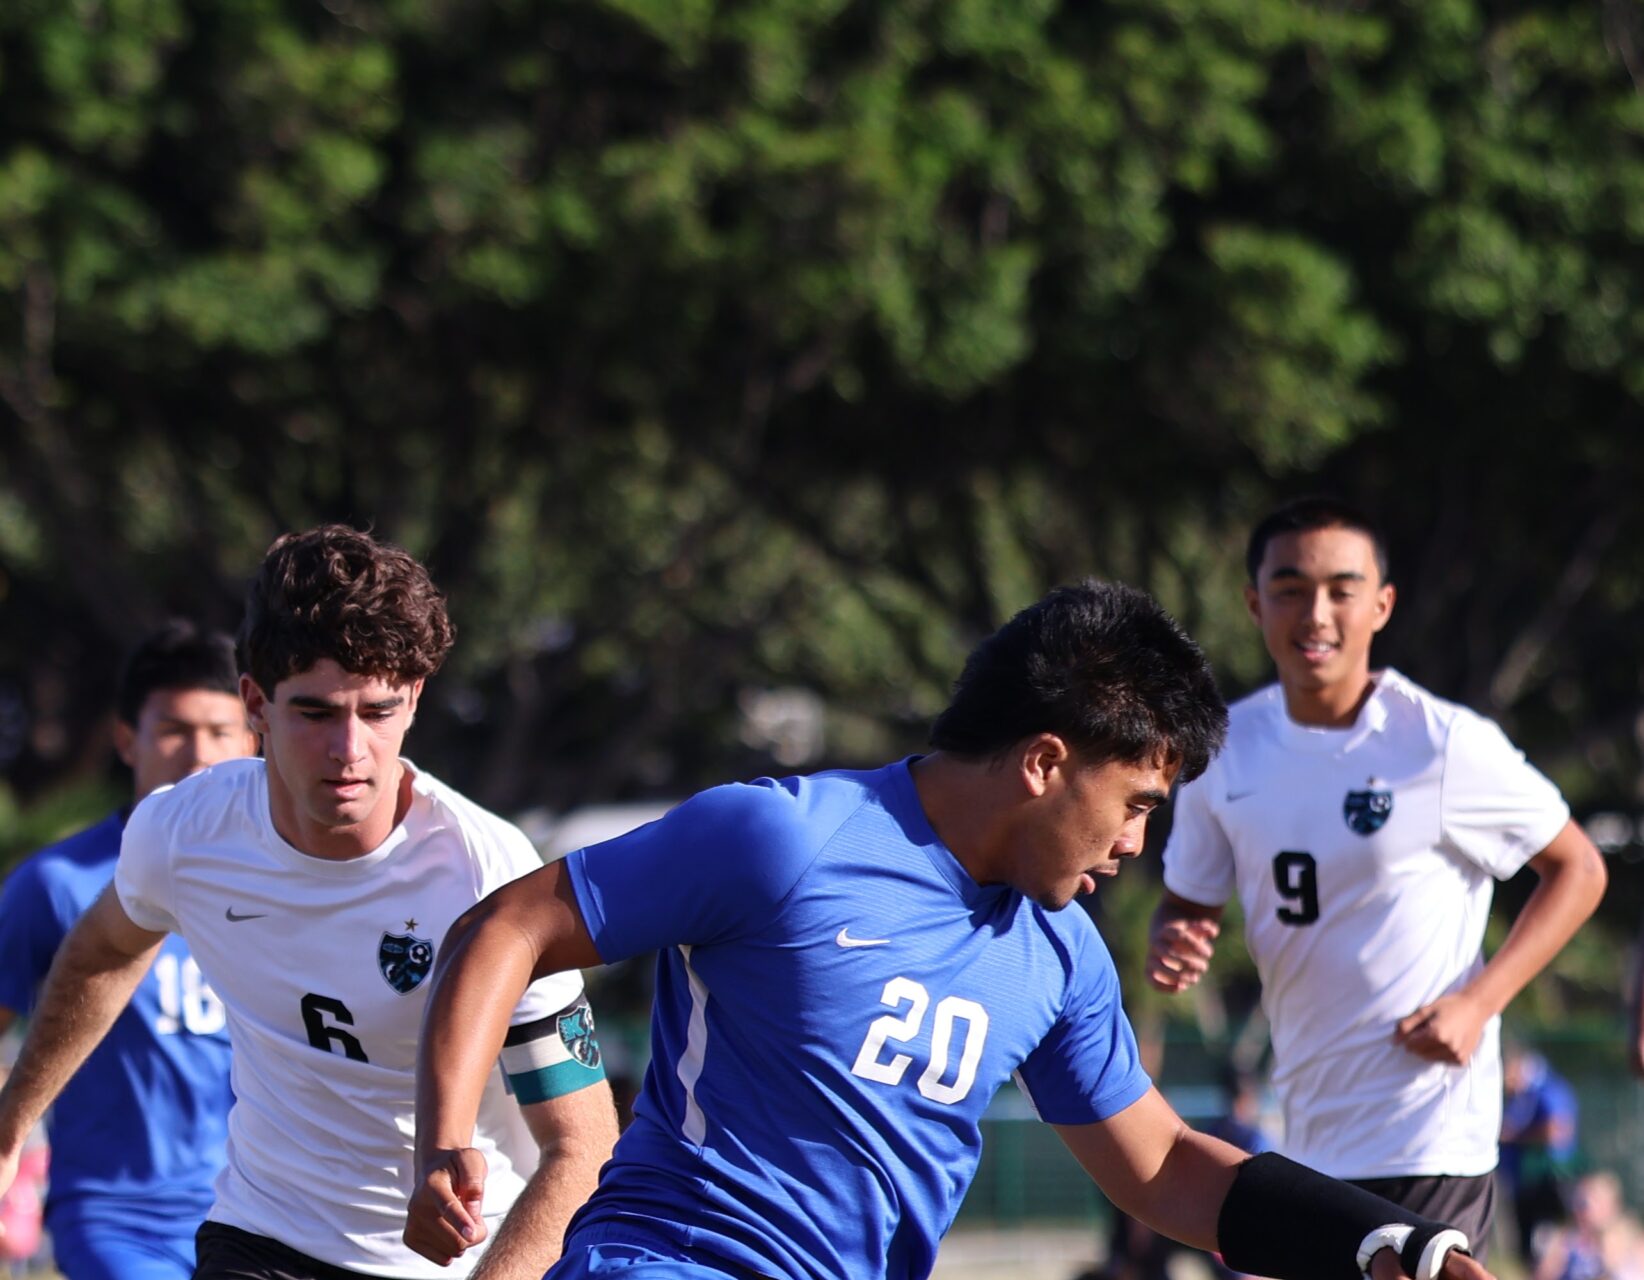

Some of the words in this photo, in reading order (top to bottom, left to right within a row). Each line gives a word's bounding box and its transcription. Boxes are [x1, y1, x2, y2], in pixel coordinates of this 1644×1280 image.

[1272, 850, 1320, 926] 9
[154, 953, 226, 1035] 16
[301, 992, 369, 1064] 6
[851, 976, 989, 1105] 20
